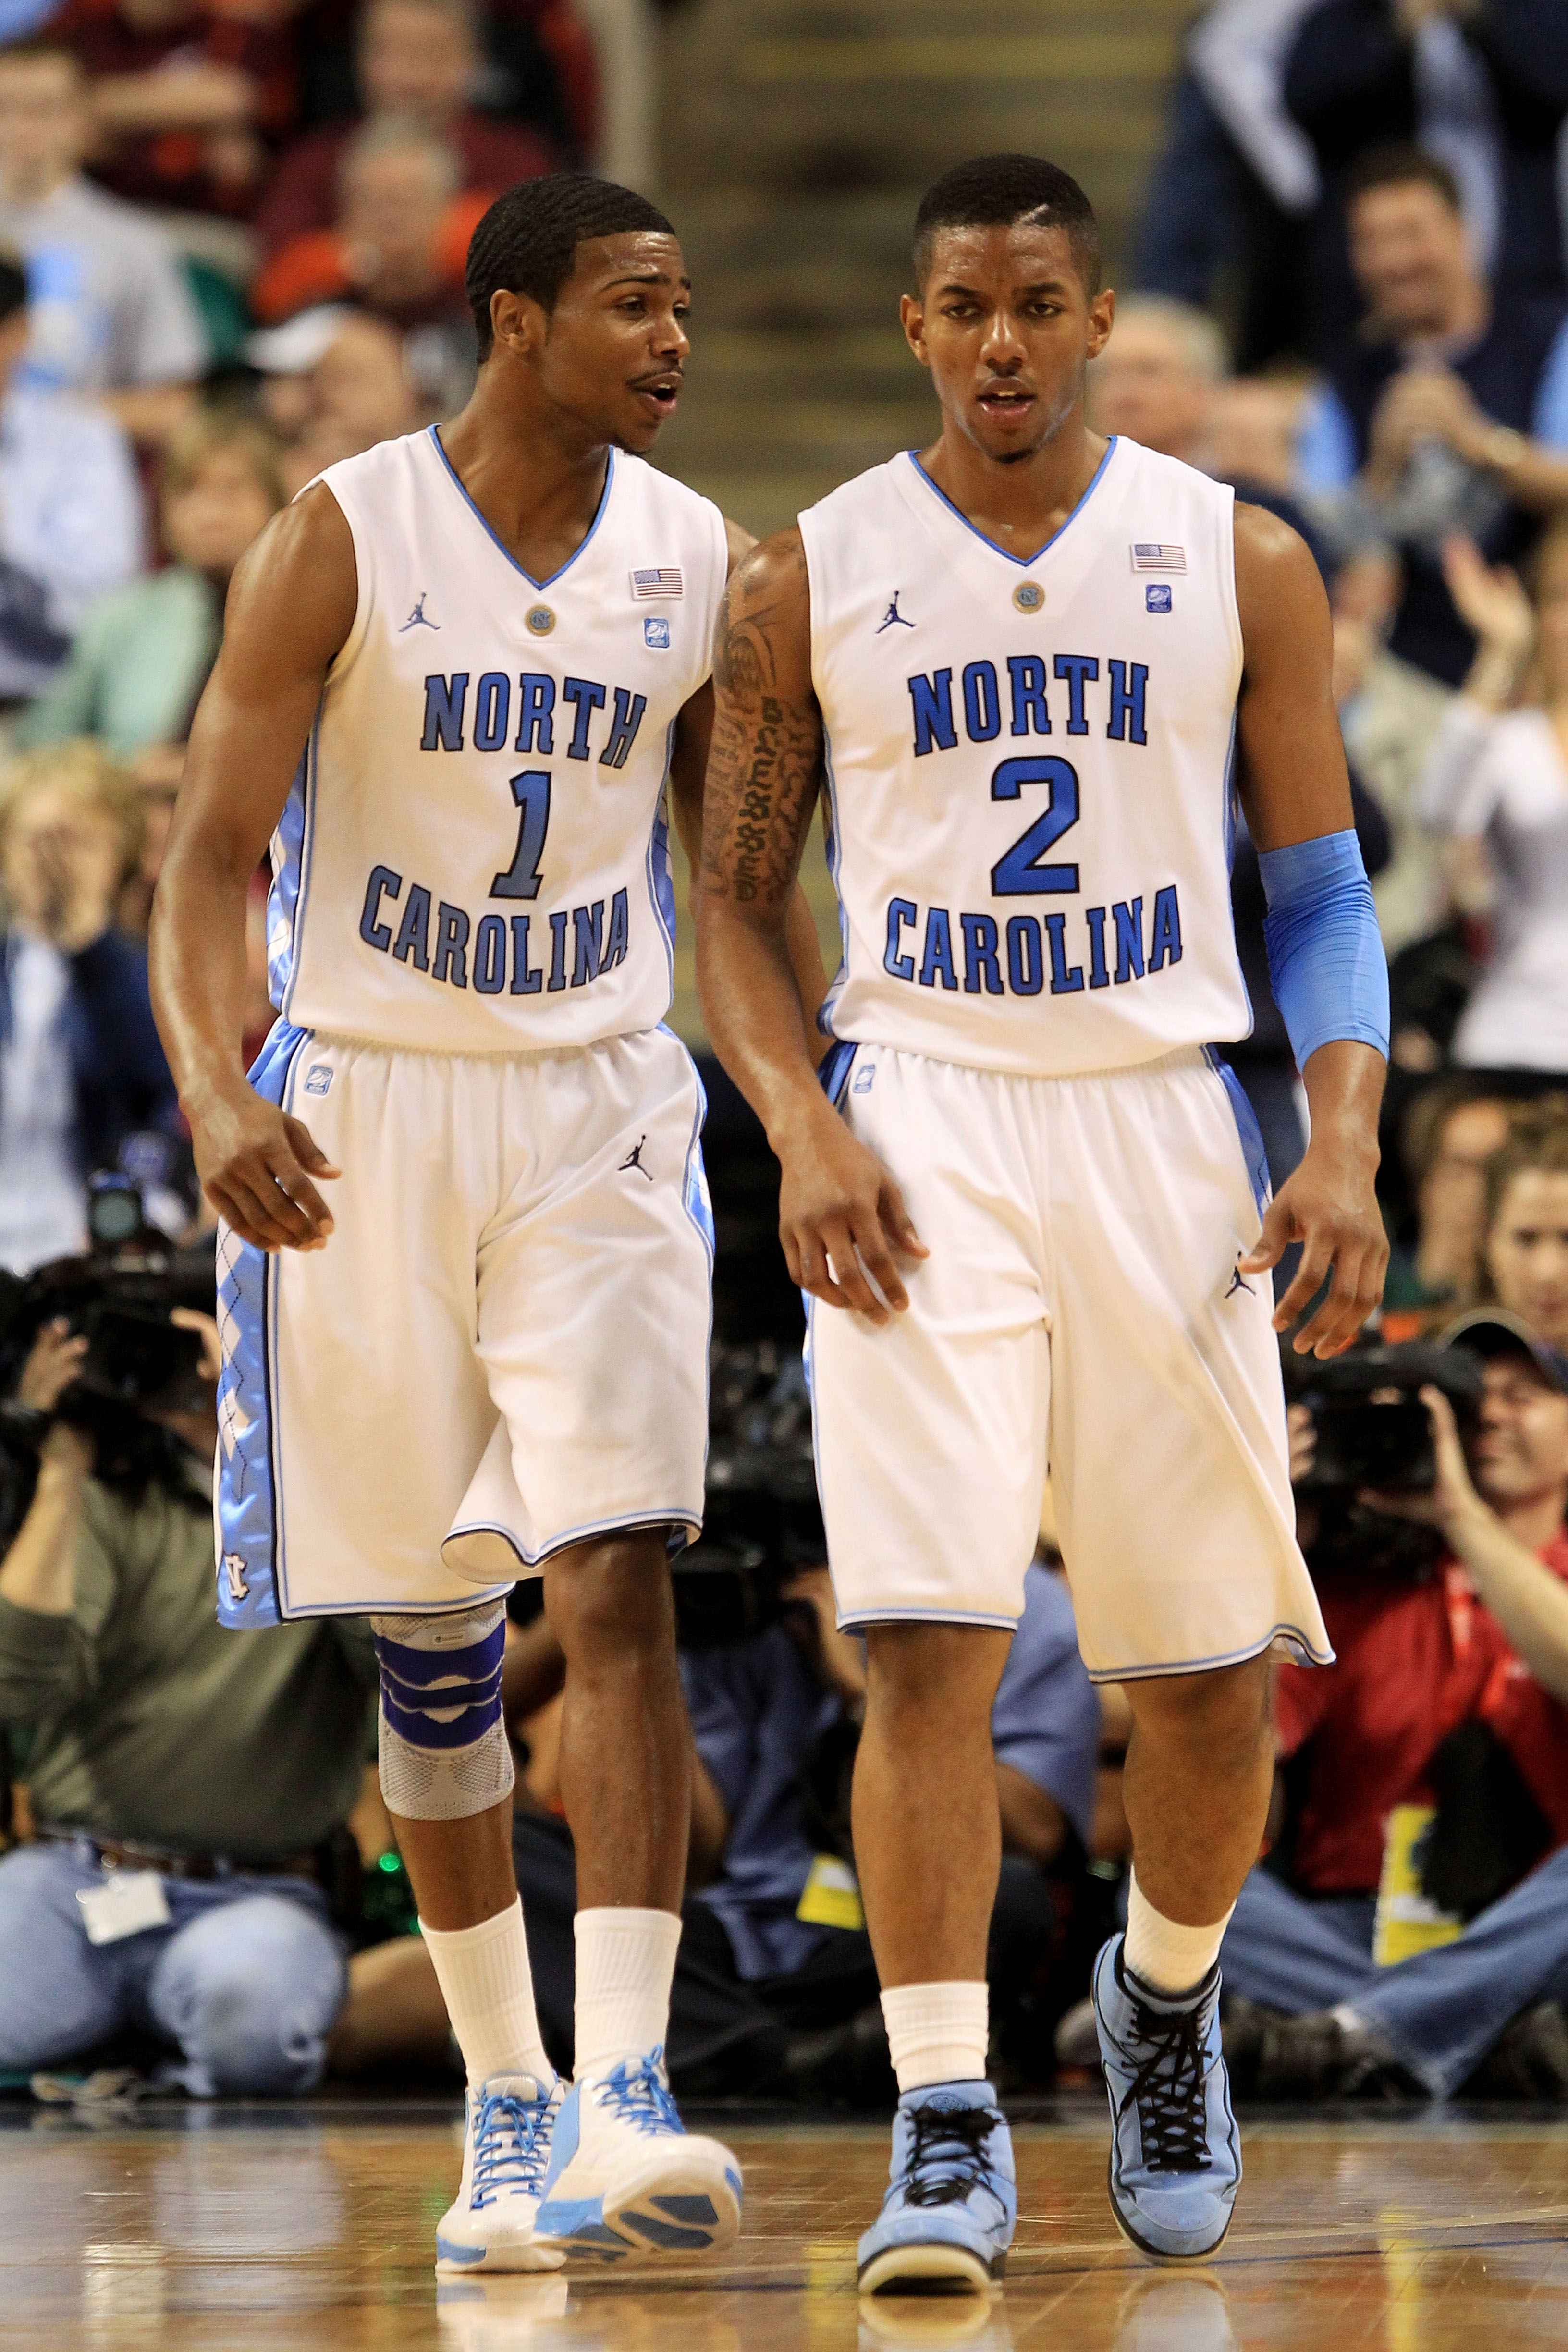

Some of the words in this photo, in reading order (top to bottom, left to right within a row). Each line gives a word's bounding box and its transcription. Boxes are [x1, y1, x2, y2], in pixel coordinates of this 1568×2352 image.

[420, 672, 647, 769] NORTH
[907, 654, 1149, 758] NORTH
[489, 770, 552, 900] 1
[991, 755, 1080, 897] 2
[359, 865, 630, 995] CAROLINA
[883, 884, 1183, 996] CAROLINA
